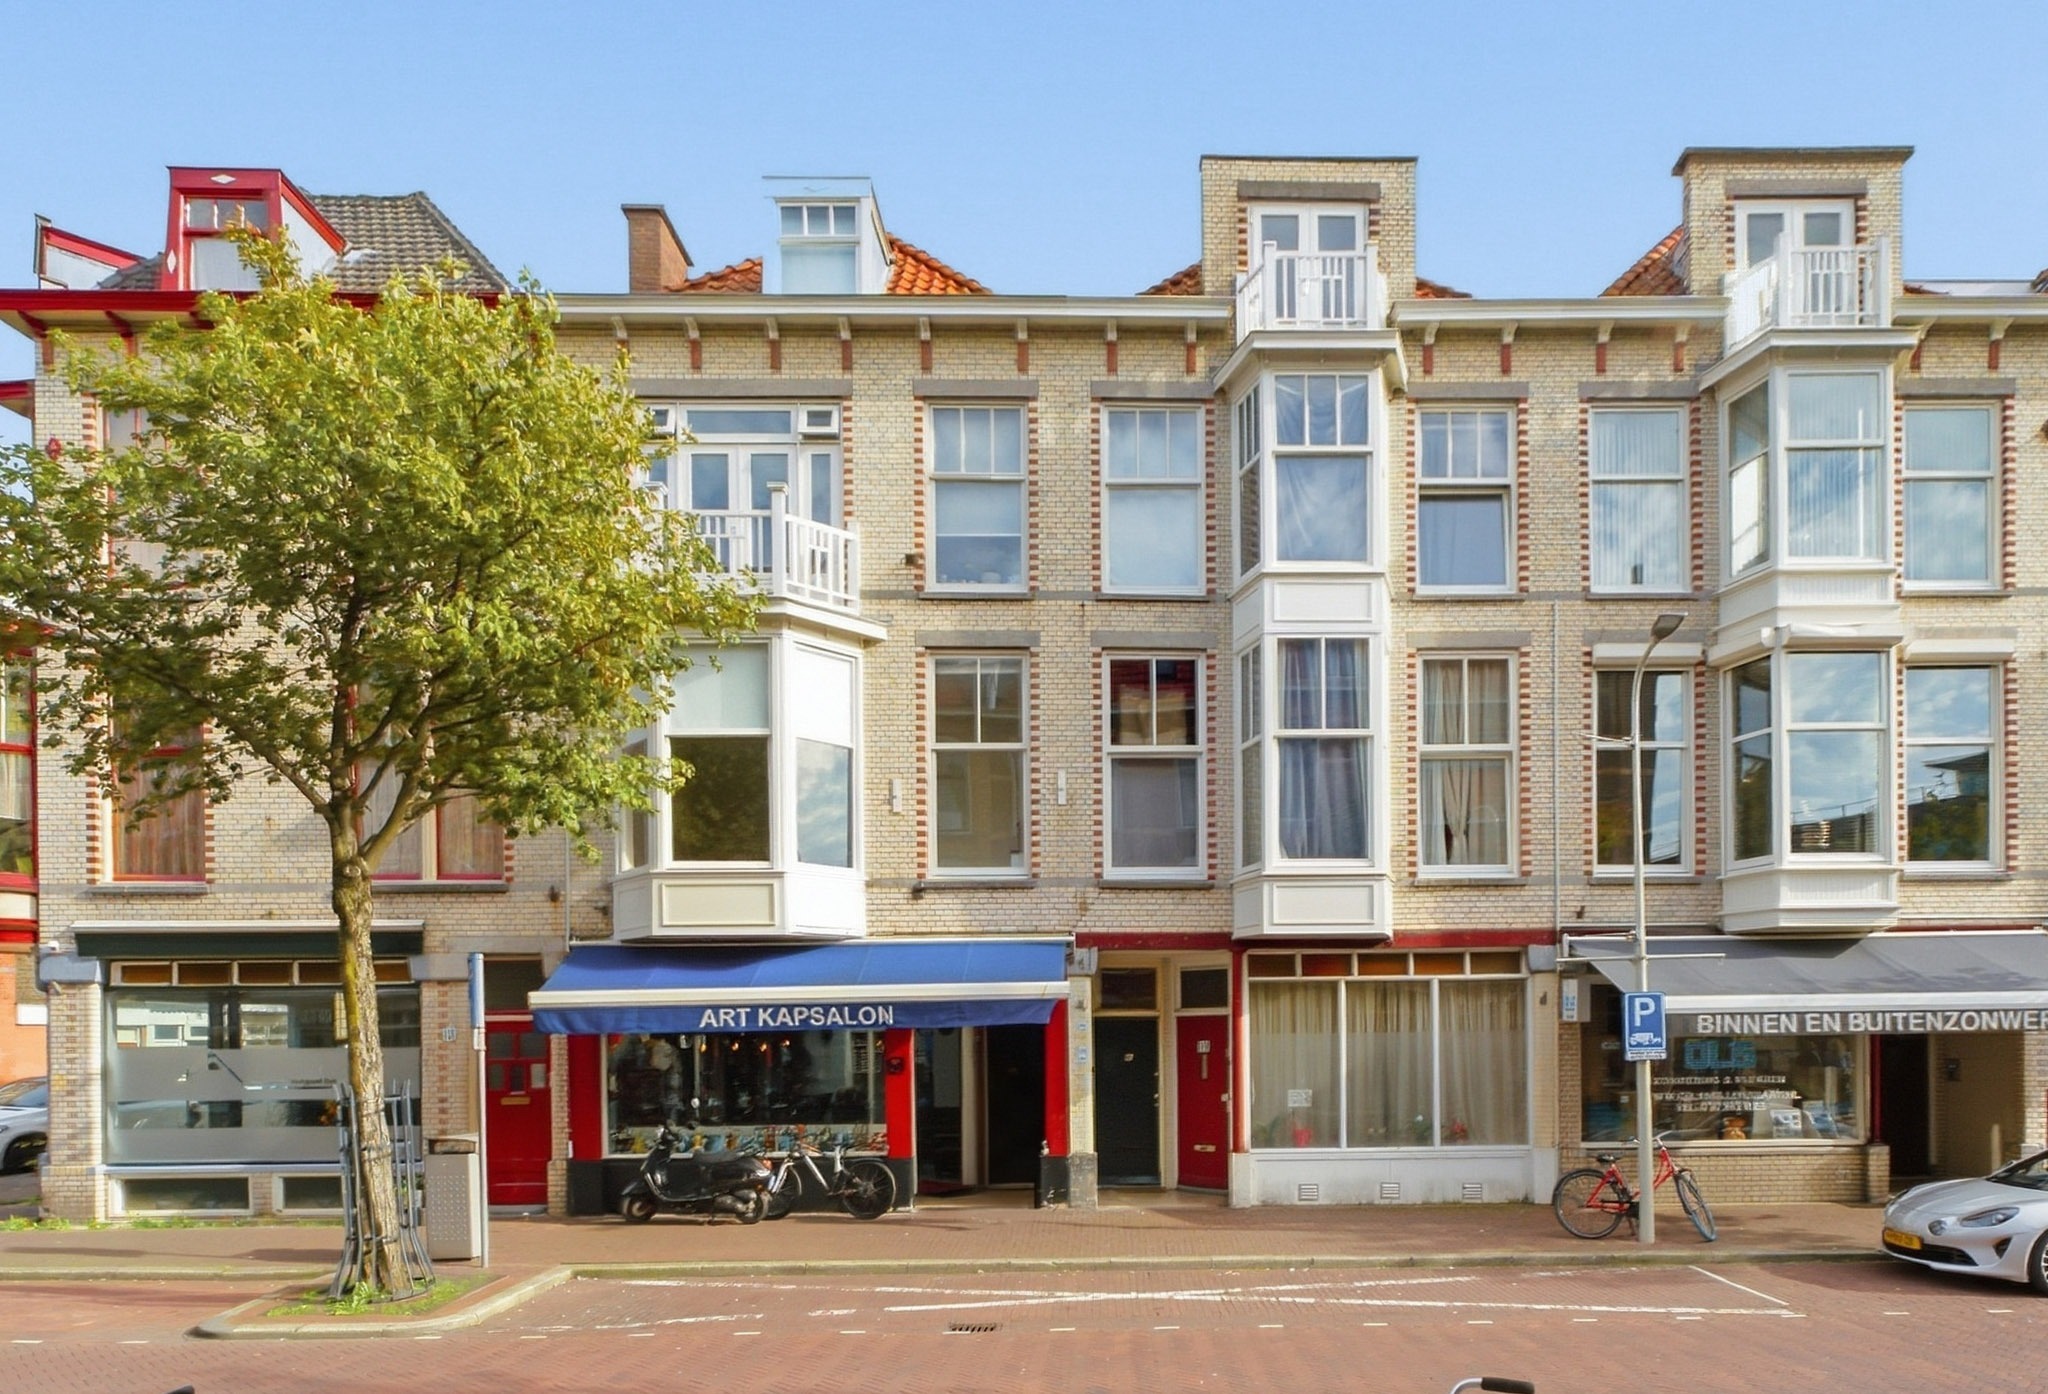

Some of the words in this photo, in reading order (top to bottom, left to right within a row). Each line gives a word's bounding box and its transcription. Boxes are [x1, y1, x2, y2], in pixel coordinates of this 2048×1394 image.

[699, 1008, 750, 1028] ART
[758, 1005, 894, 1027] KAPSALON
[1634, 997, 1655, 1027] P
[1697, 1013, 1797, 1034] BINNEN
[1805, 1012, 1841, 1032] EN
